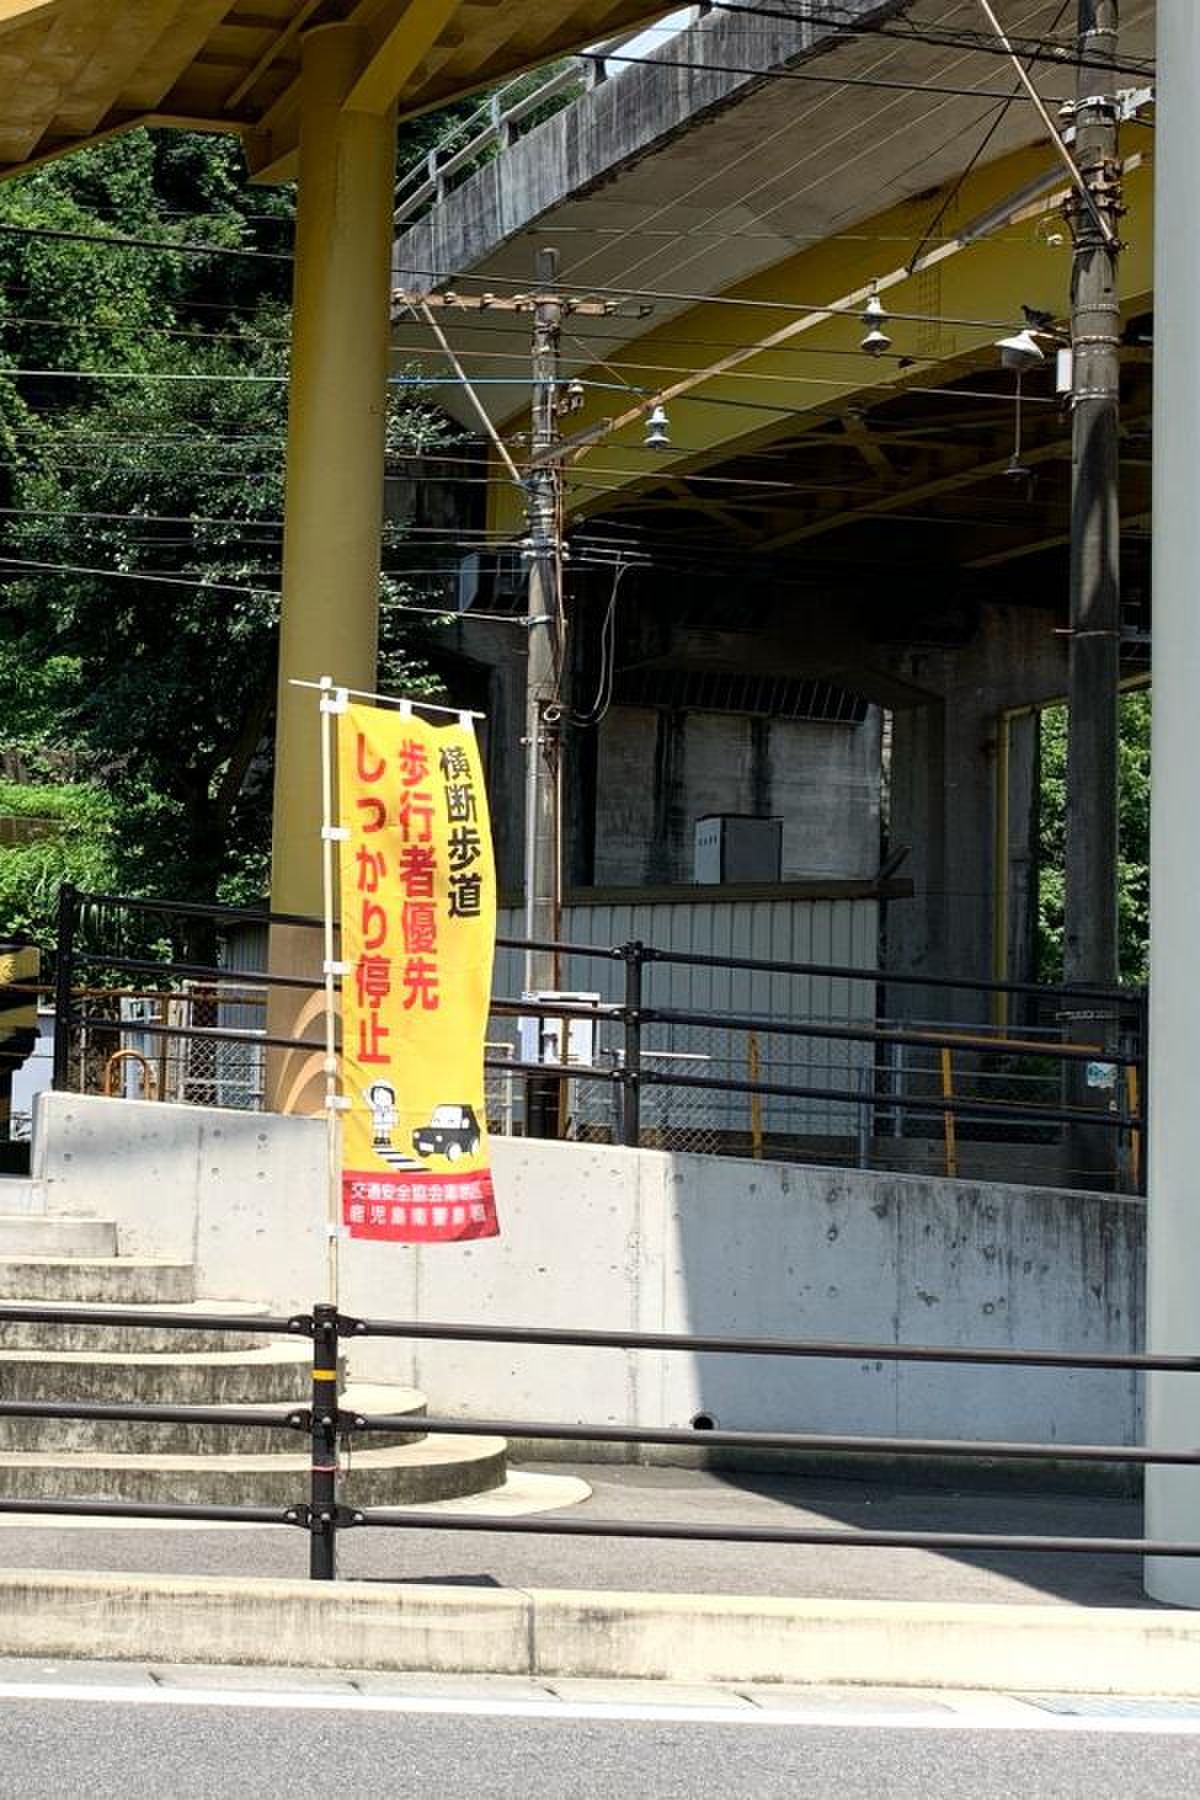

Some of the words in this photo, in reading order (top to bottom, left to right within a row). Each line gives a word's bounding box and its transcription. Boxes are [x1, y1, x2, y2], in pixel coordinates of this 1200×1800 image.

[399, 739, 440, 1010] 歩行者優先
[439, 746, 482, 919] 横断歩道
